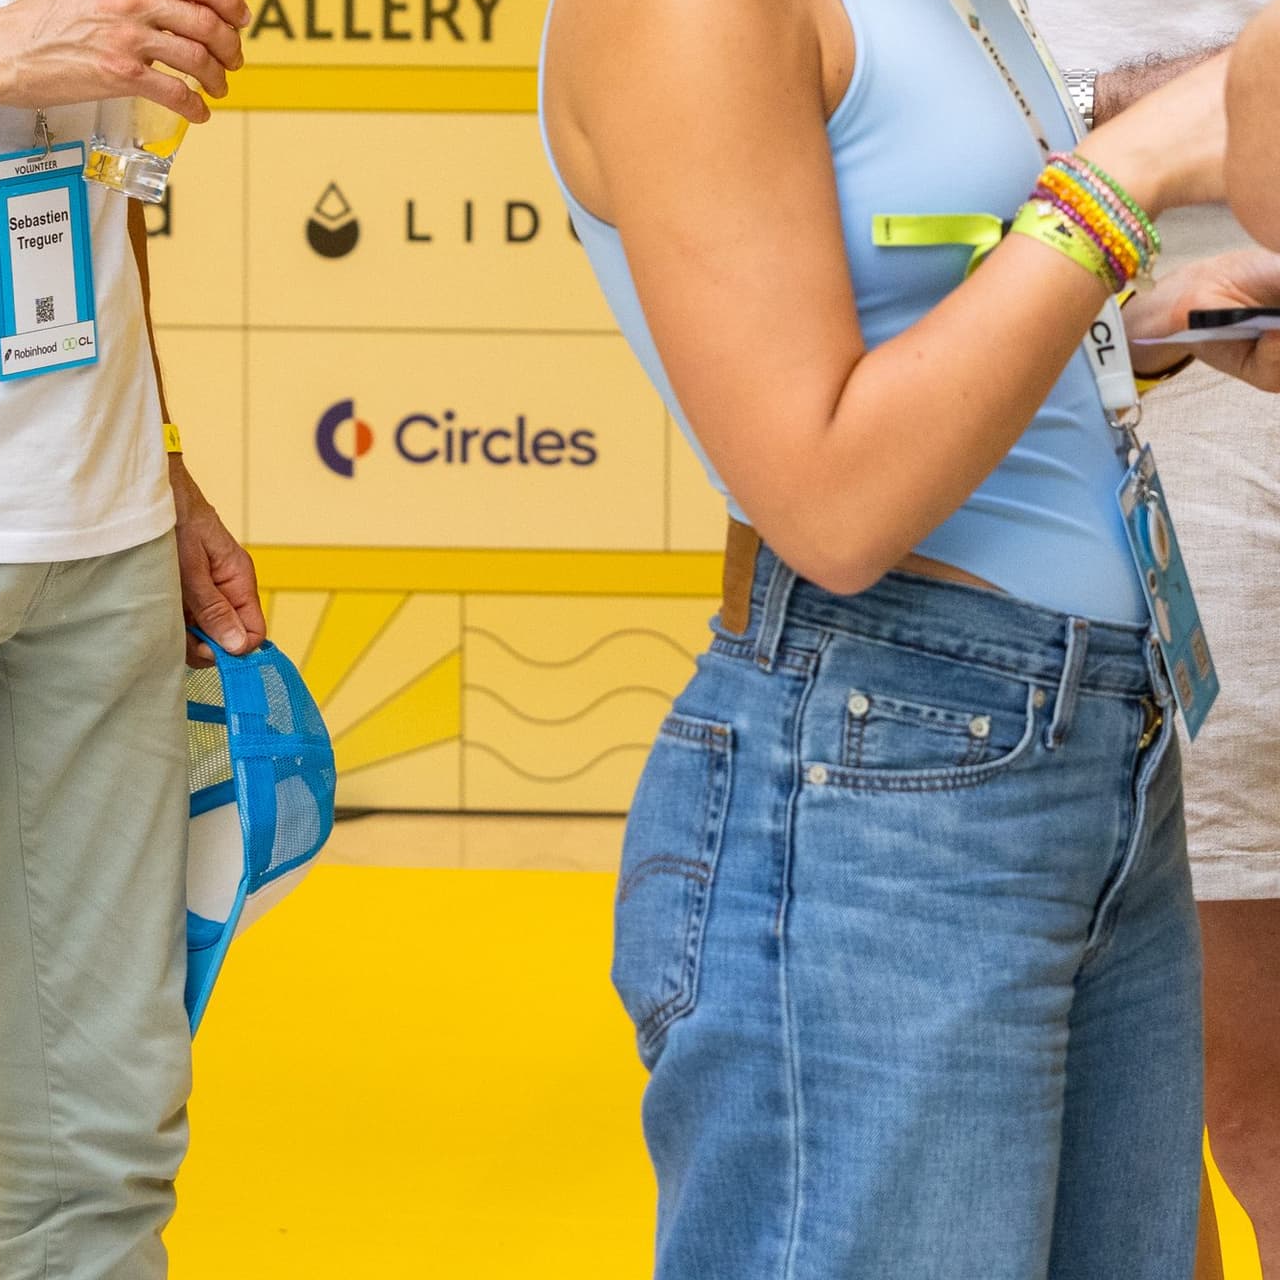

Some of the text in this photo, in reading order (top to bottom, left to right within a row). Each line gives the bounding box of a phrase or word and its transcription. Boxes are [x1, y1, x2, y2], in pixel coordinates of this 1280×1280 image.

[14, 159, 57, 175] VOLUNTEER
[9, 209, 69, 231] Sebastien
[405, 199, 582, 244] LID
[17, 231, 64, 250] Treguer
[14, 336, 93, 360] Robinhood CL
[1091, 321, 1115, 366] CL
[394, 410, 598, 467] Circles
